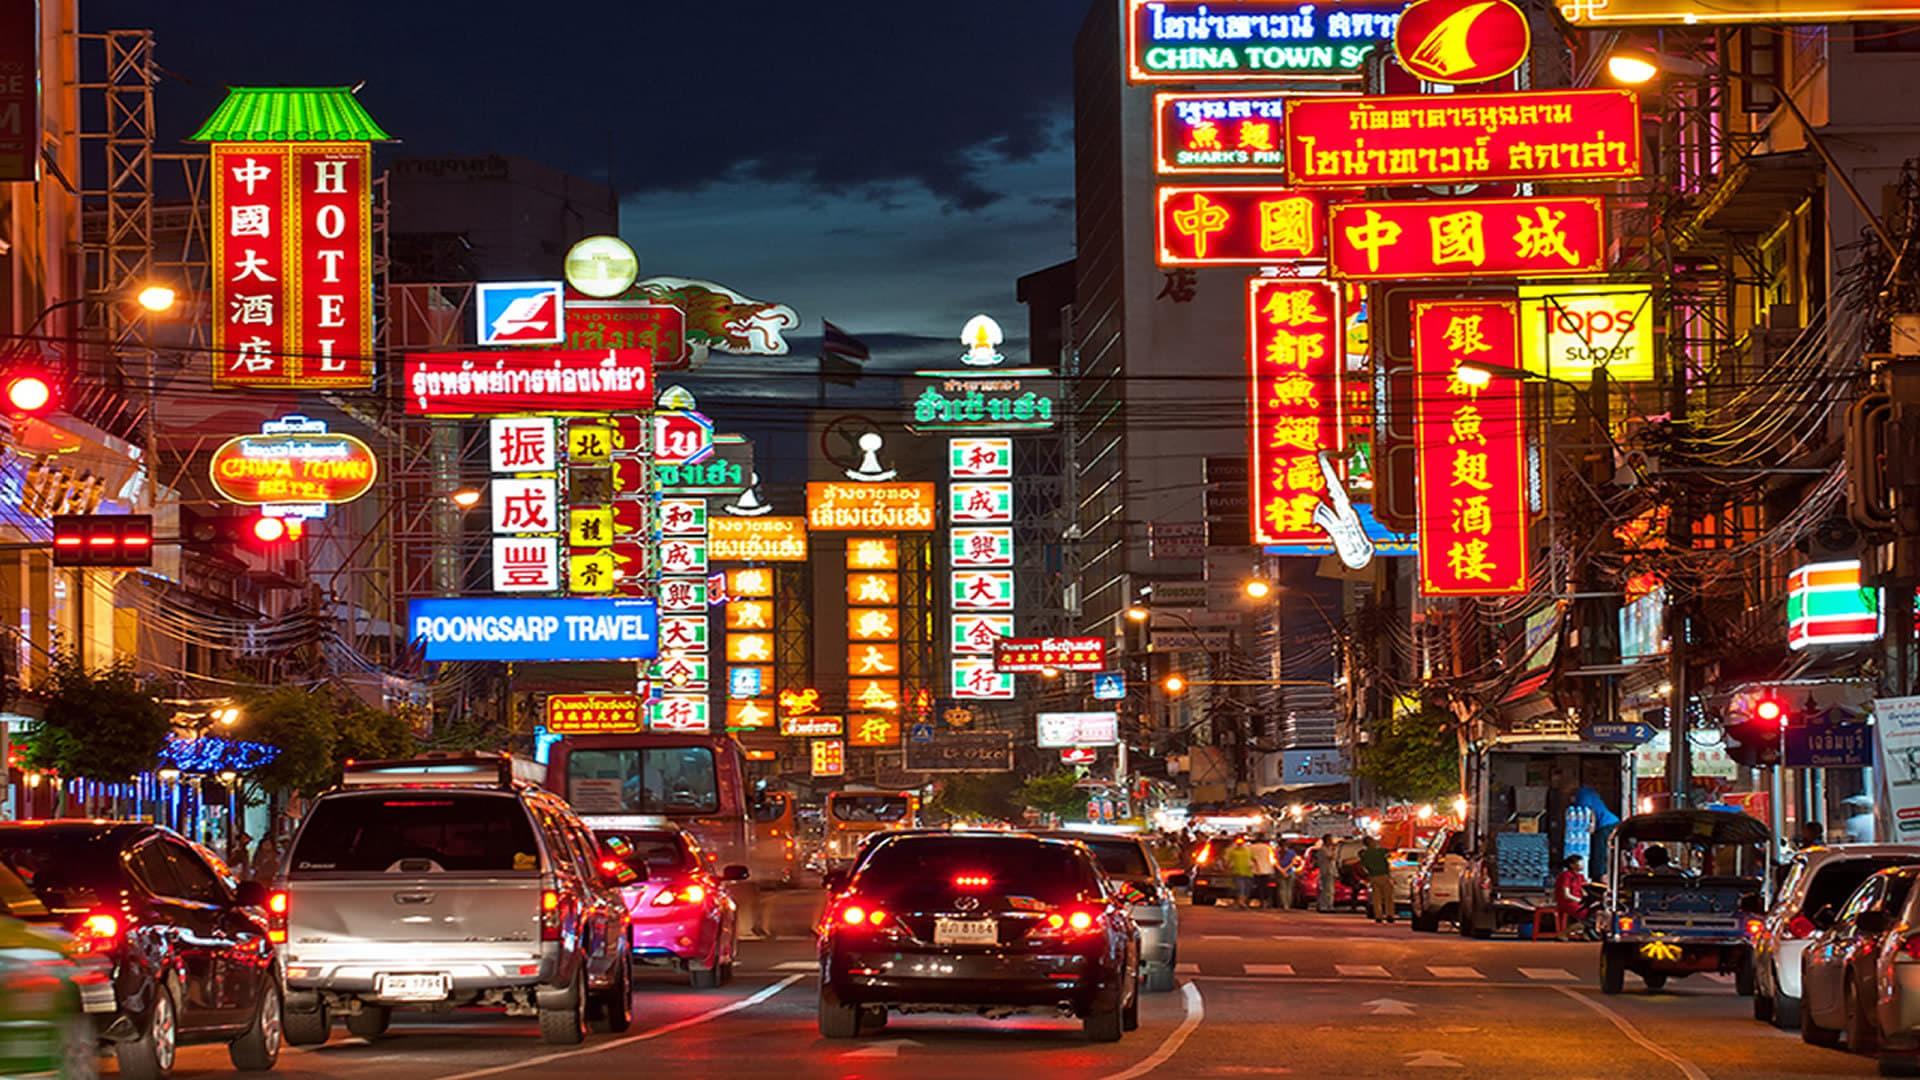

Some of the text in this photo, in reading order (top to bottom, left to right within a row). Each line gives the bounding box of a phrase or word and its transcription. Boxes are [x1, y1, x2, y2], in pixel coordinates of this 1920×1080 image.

[1147, 4, 1315, 40] ไชน่าทาวน์
[1146, 46, 1238, 69] CHINA
[1245, 46, 1333, 69] TOWN
[1350, 103, 1573, 132] ภัตตาคารหูฉลาม
[1177, 149, 1249, 164] SHARK'S
[1297, 129, 1627, 176] ไชน่าทาวน์ สกาล่า
[1173, 193, 1314, 258] 中國
[1345, 206, 1581, 273] 中國城
[230, 158, 276, 374] 中國大酒店
[313, 160, 347, 372] HOTEL
[1536, 305, 1636, 344] Tops
[1566, 346, 1635, 366] super
[412, 349, 646, 410] รุ่งทรัพย์การท่องเที่ยว
[499, 426, 549, 587] 振成豐
[416, 614, 650, 643] ROONGSARP TRAVEL
